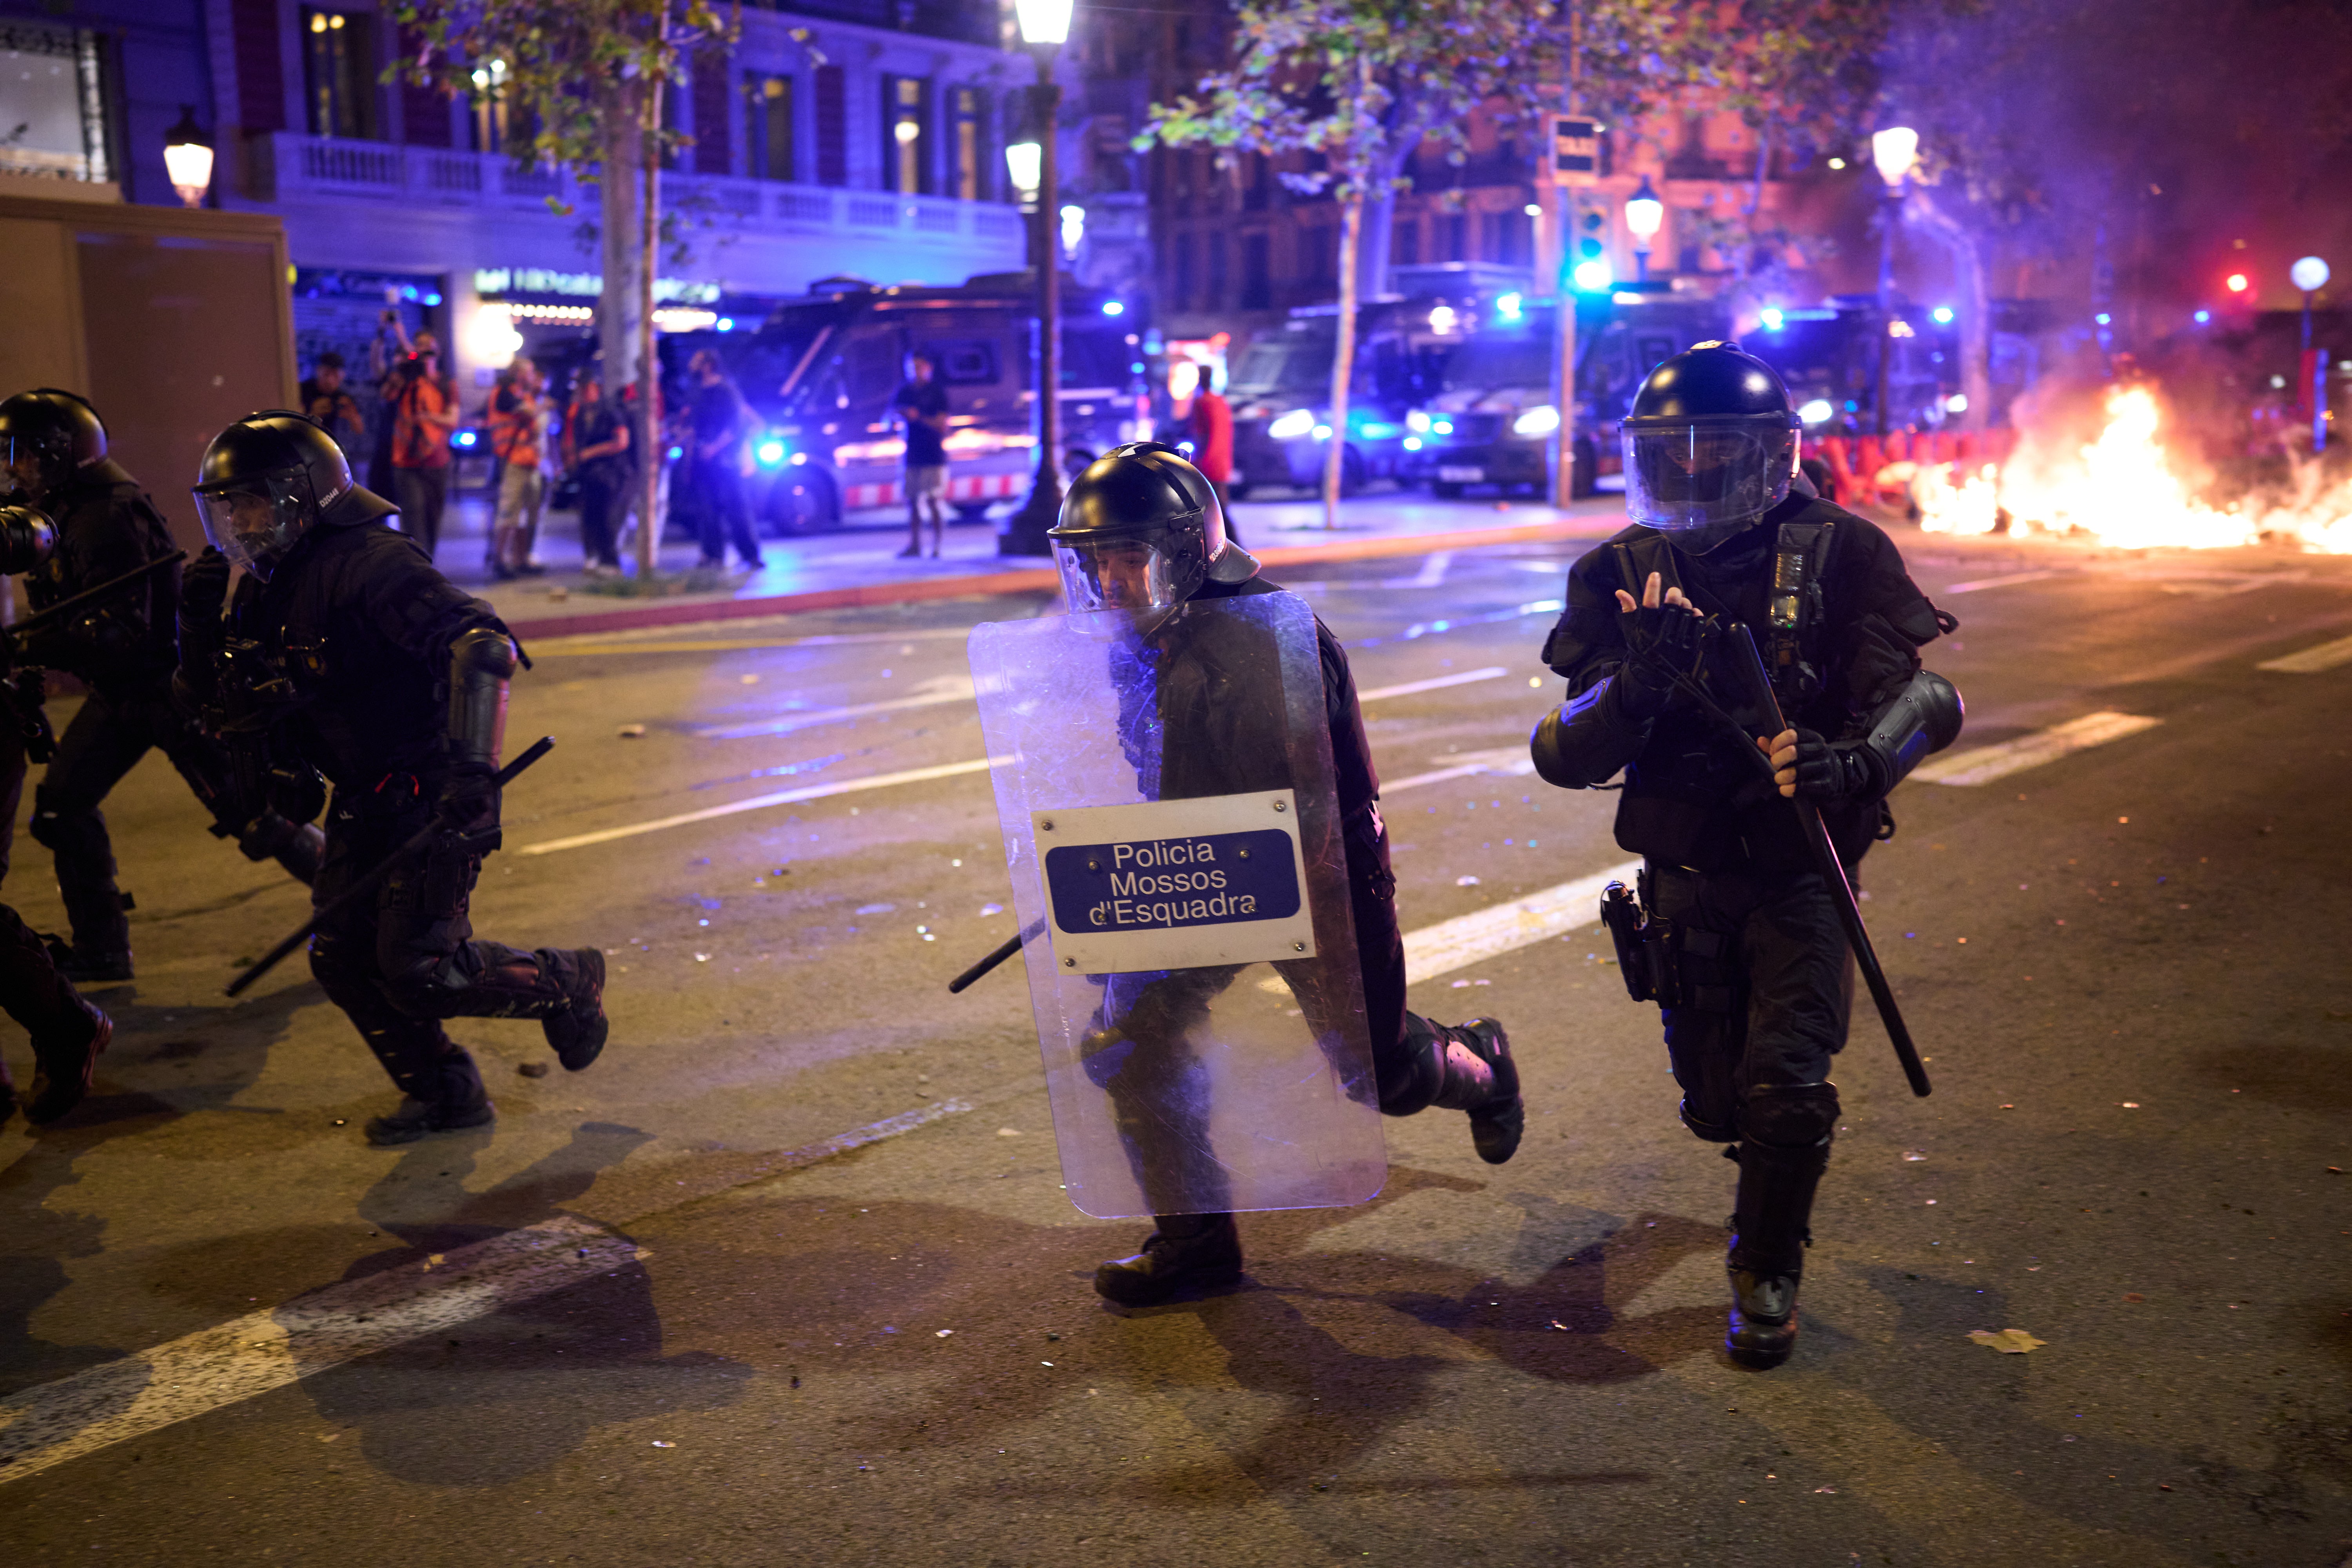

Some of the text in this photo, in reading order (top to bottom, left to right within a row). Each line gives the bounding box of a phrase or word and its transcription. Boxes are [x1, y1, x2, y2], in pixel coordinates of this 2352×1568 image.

[1113, 839, 1215, 869] Policia
[1110, 870, 1227, 896] Mossos
[1089, 892, 1255, 926] d'Esquadra
